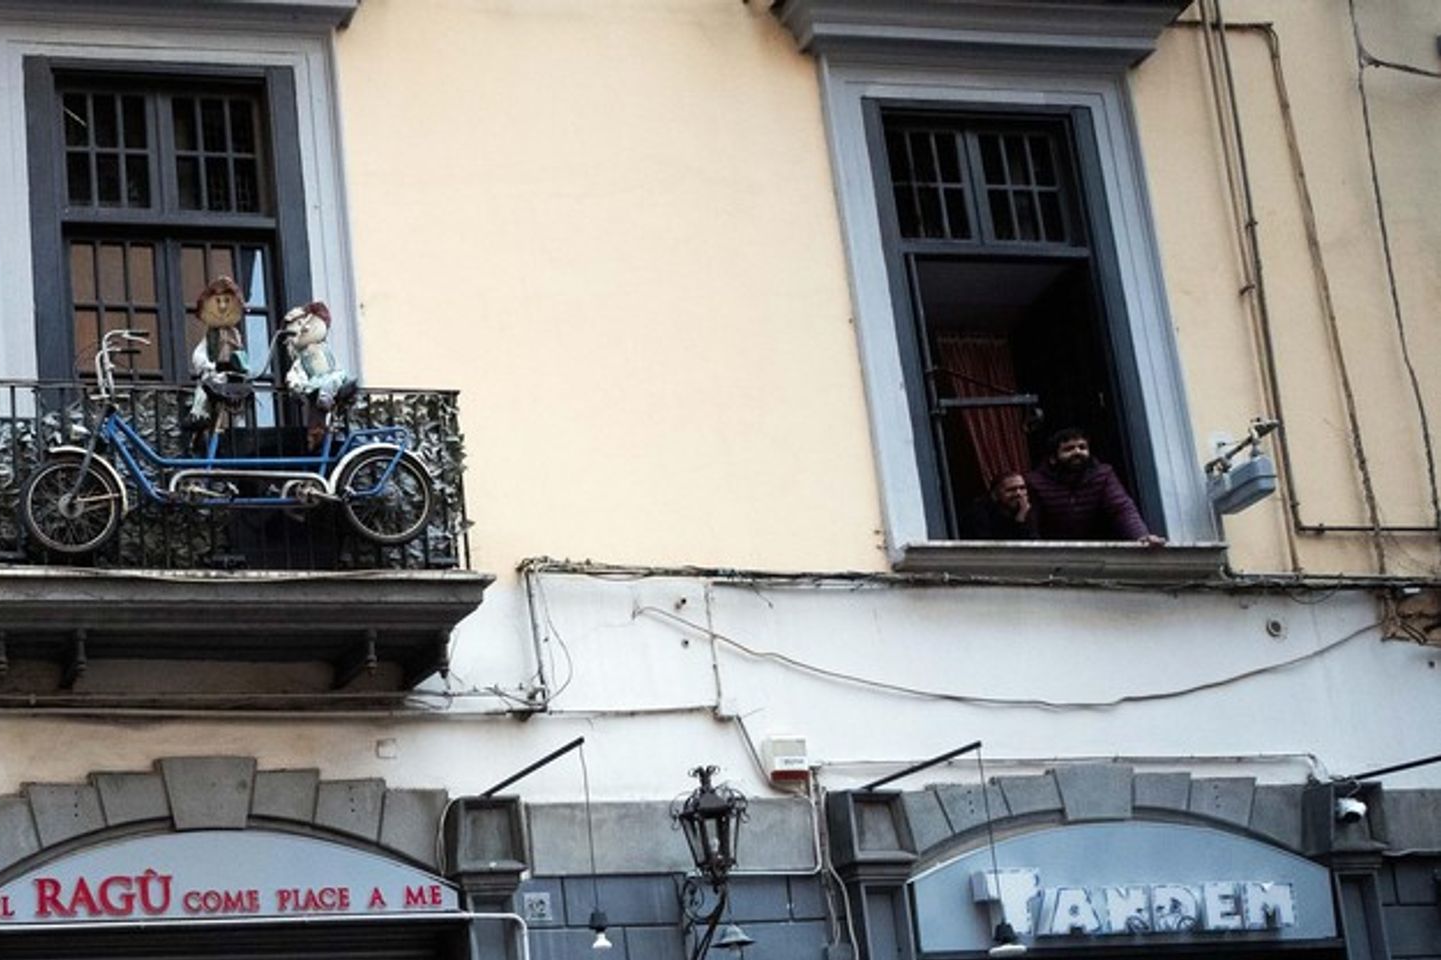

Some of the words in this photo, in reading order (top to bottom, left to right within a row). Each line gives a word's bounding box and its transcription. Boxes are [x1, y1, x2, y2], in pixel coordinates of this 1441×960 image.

[183, 889, 260, 913] COME
[368, 886, 387, 908] A
[404, 884, 443, 907] ME
[971, 866, 1298, 937] TANDEM
